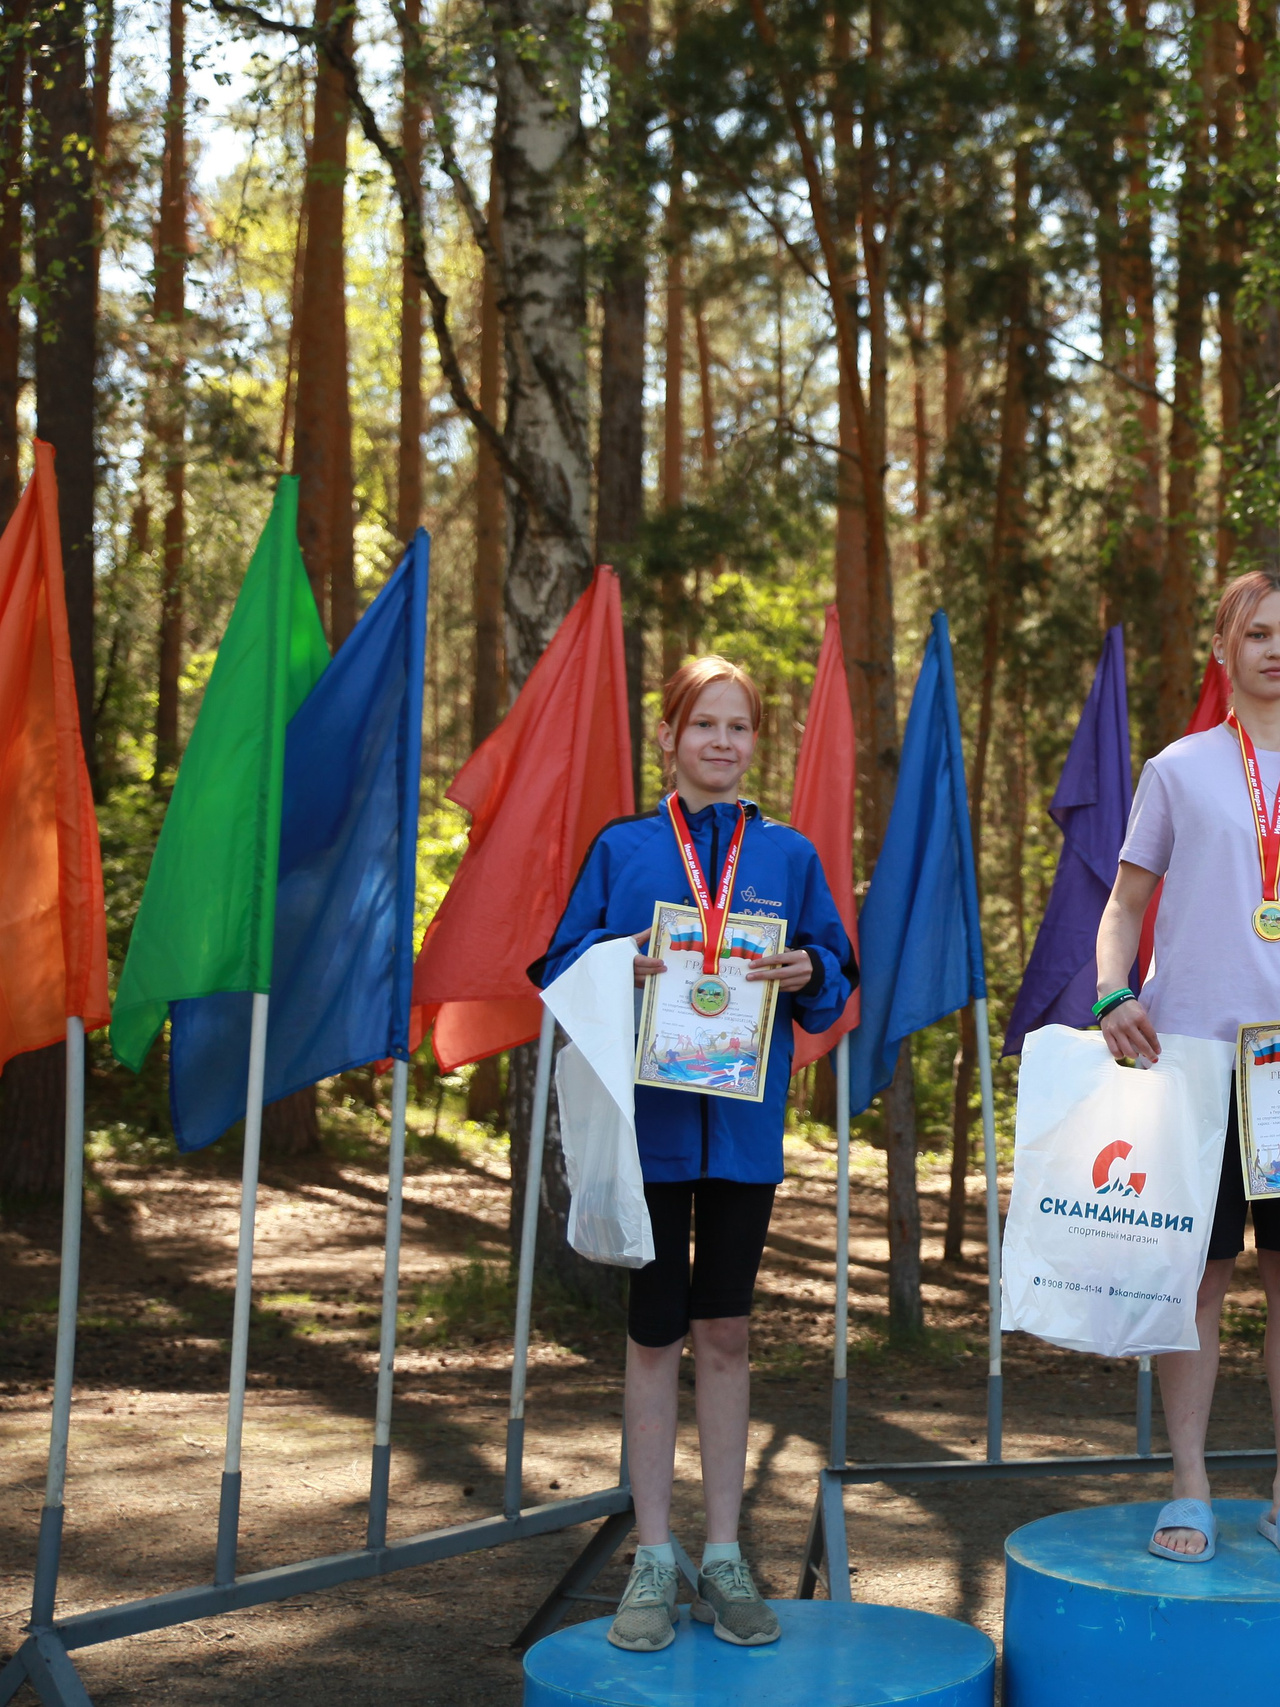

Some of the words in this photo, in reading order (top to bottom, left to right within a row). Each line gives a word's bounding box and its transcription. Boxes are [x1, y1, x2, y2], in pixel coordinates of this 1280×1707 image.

[1247, 758, 1256, 777] Иван
[1253, 788, 1262, 811] Марья
[1258, 814, 1266, 823] 15
[684, 843, 693, 860] Иван
[692, 869, 702, 889] Марья
[701, 898, 709, 910] лет
[717, 895, 726, 909] Иван
[723, 865, 732, 885] Марья
[728, 854, 735, 863] 15
[749, 898, 782, 907] NORD
[1039, 1197, 1194, 1233] СКАНДИНАВИЯ
[1068, 1226, 1119, 1239] спортивный
[1120, 1234, 1158, 1245] магазин
[1042, 1278, 1046, 1286] 8
[1048, 1279, 1063, 1289] 908
[1065, 1282, 1102, 1294] 708-41-14
[1114, 1289, 1182, 1304] skandinavia74.ru
